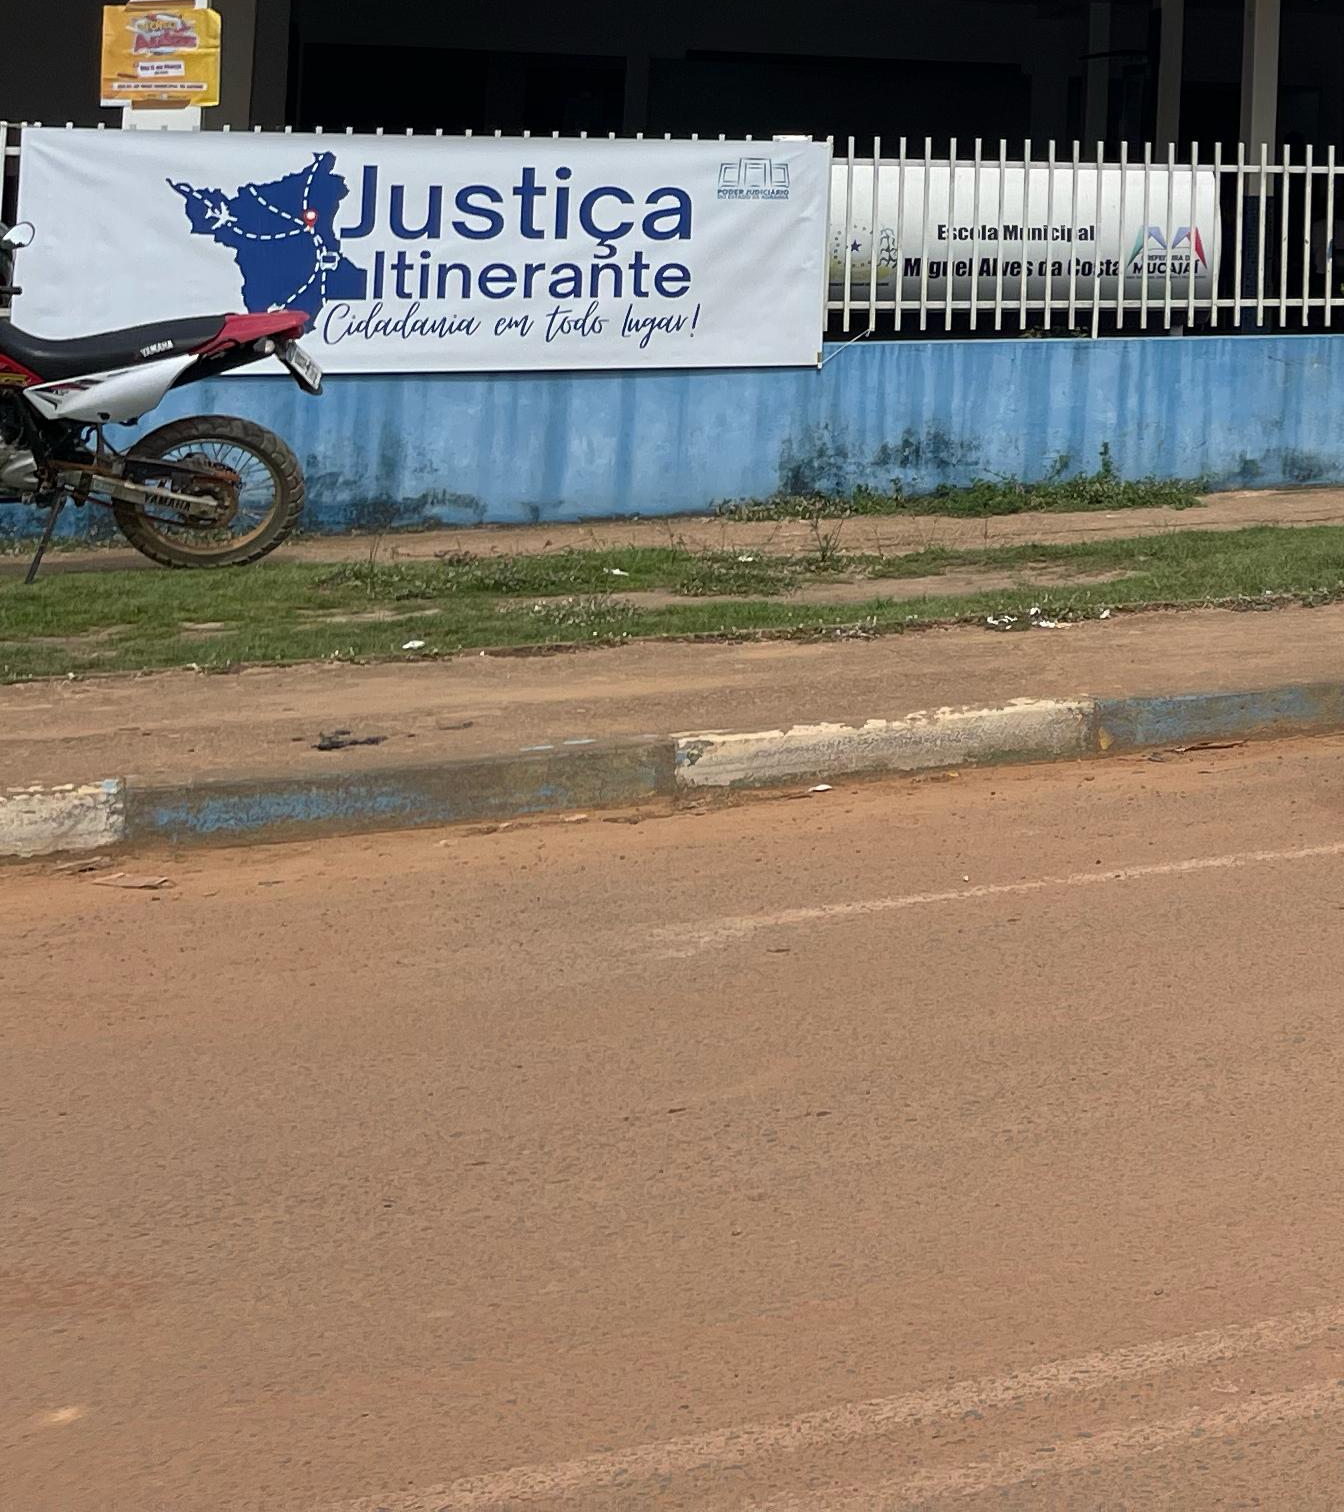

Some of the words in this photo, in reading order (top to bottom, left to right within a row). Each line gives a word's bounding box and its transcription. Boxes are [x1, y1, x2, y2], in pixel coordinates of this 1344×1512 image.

[340, 165, 692, 259] Justiça
[372, 250, 692, 300] Itinerante
[903, 257, 973, 279] Mguel
[140, 339, 174, 358] YAMAHA
[323, 301, 482, 345] Cidadania
[494, 313, 535, 338] em
[545, 300, 609, 343] todo
[621, 303, 701, 349] lugar!
